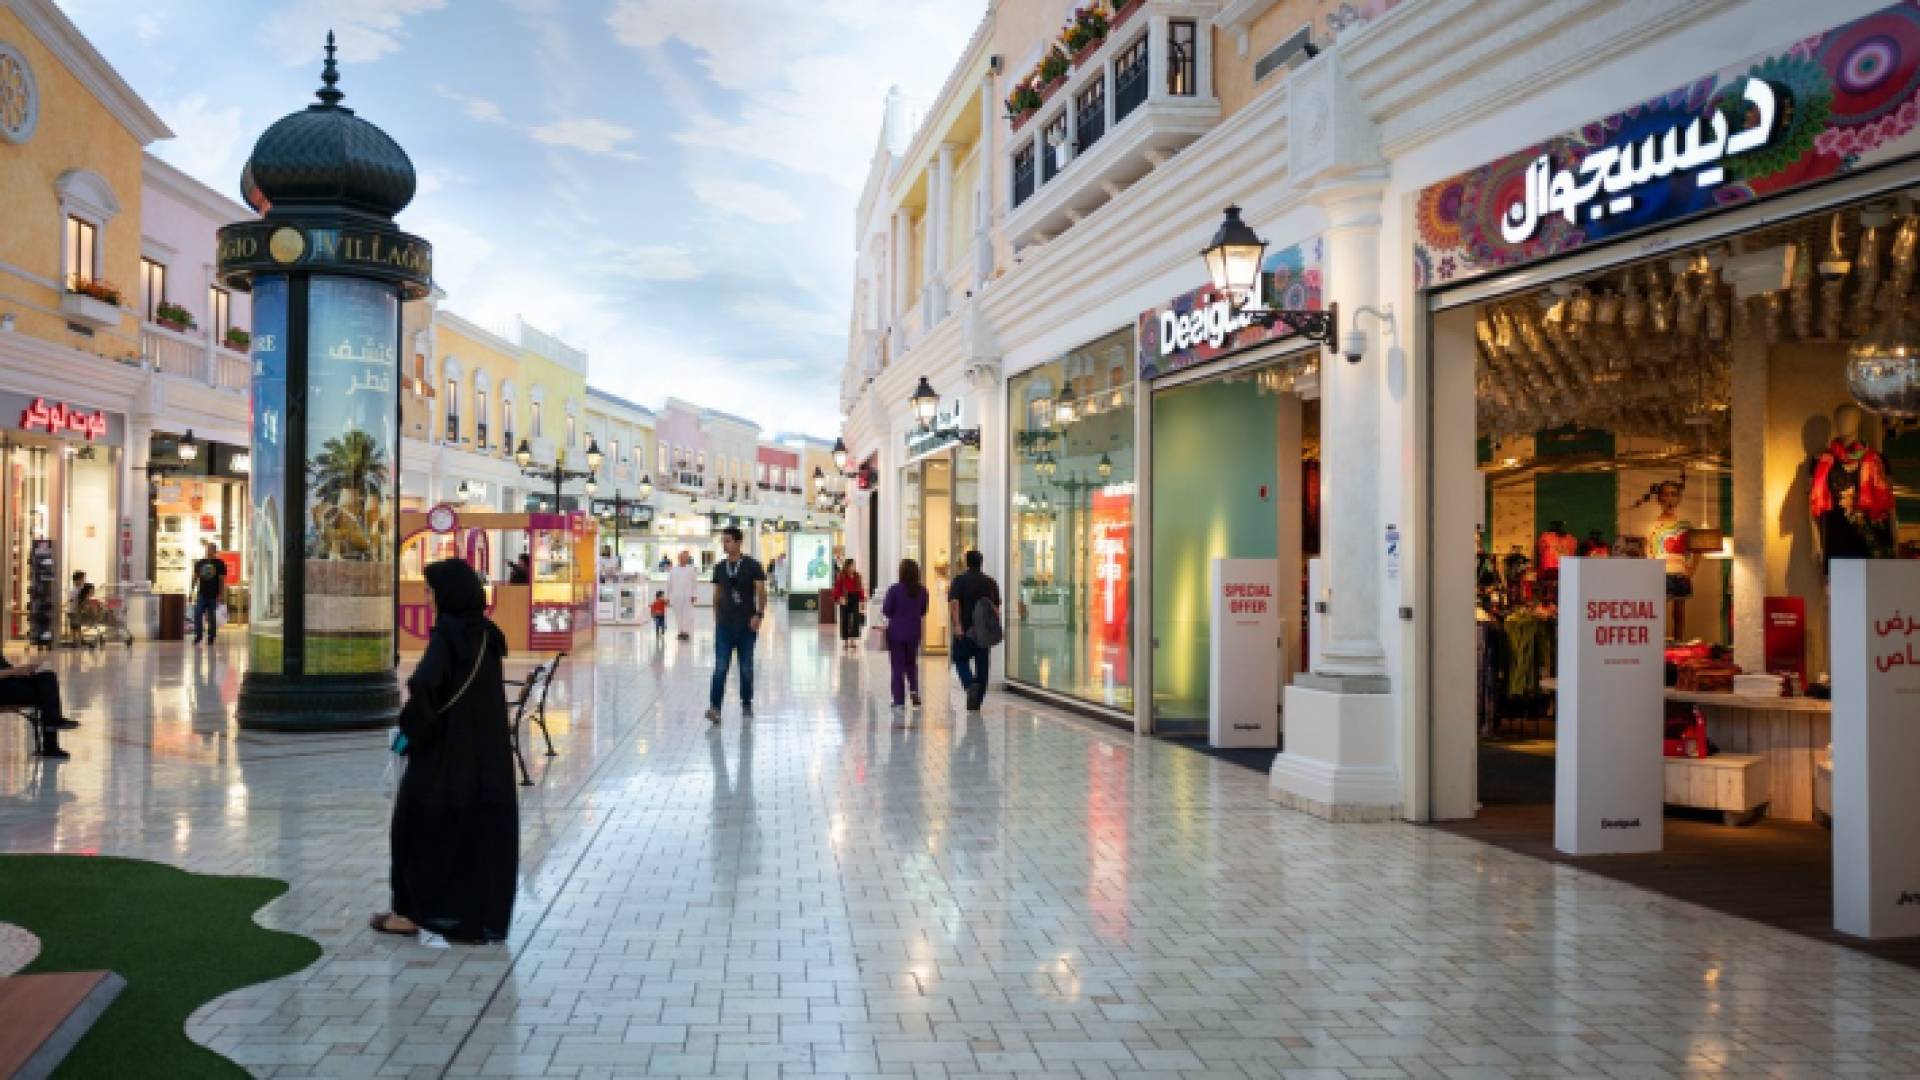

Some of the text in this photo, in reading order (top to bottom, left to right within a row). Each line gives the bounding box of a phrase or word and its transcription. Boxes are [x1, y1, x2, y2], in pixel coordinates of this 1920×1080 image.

[1224, 583, 1273, 598] SPECIAL
[1229, 600, 1268, 614] OFFER
[1586, 601, 1658, 619] SPECIAL
[1874, 609, 1920, 636] رض
[1595, 625, 1649, 646] OFFER
[1874, 642, 1920, 673] اص
